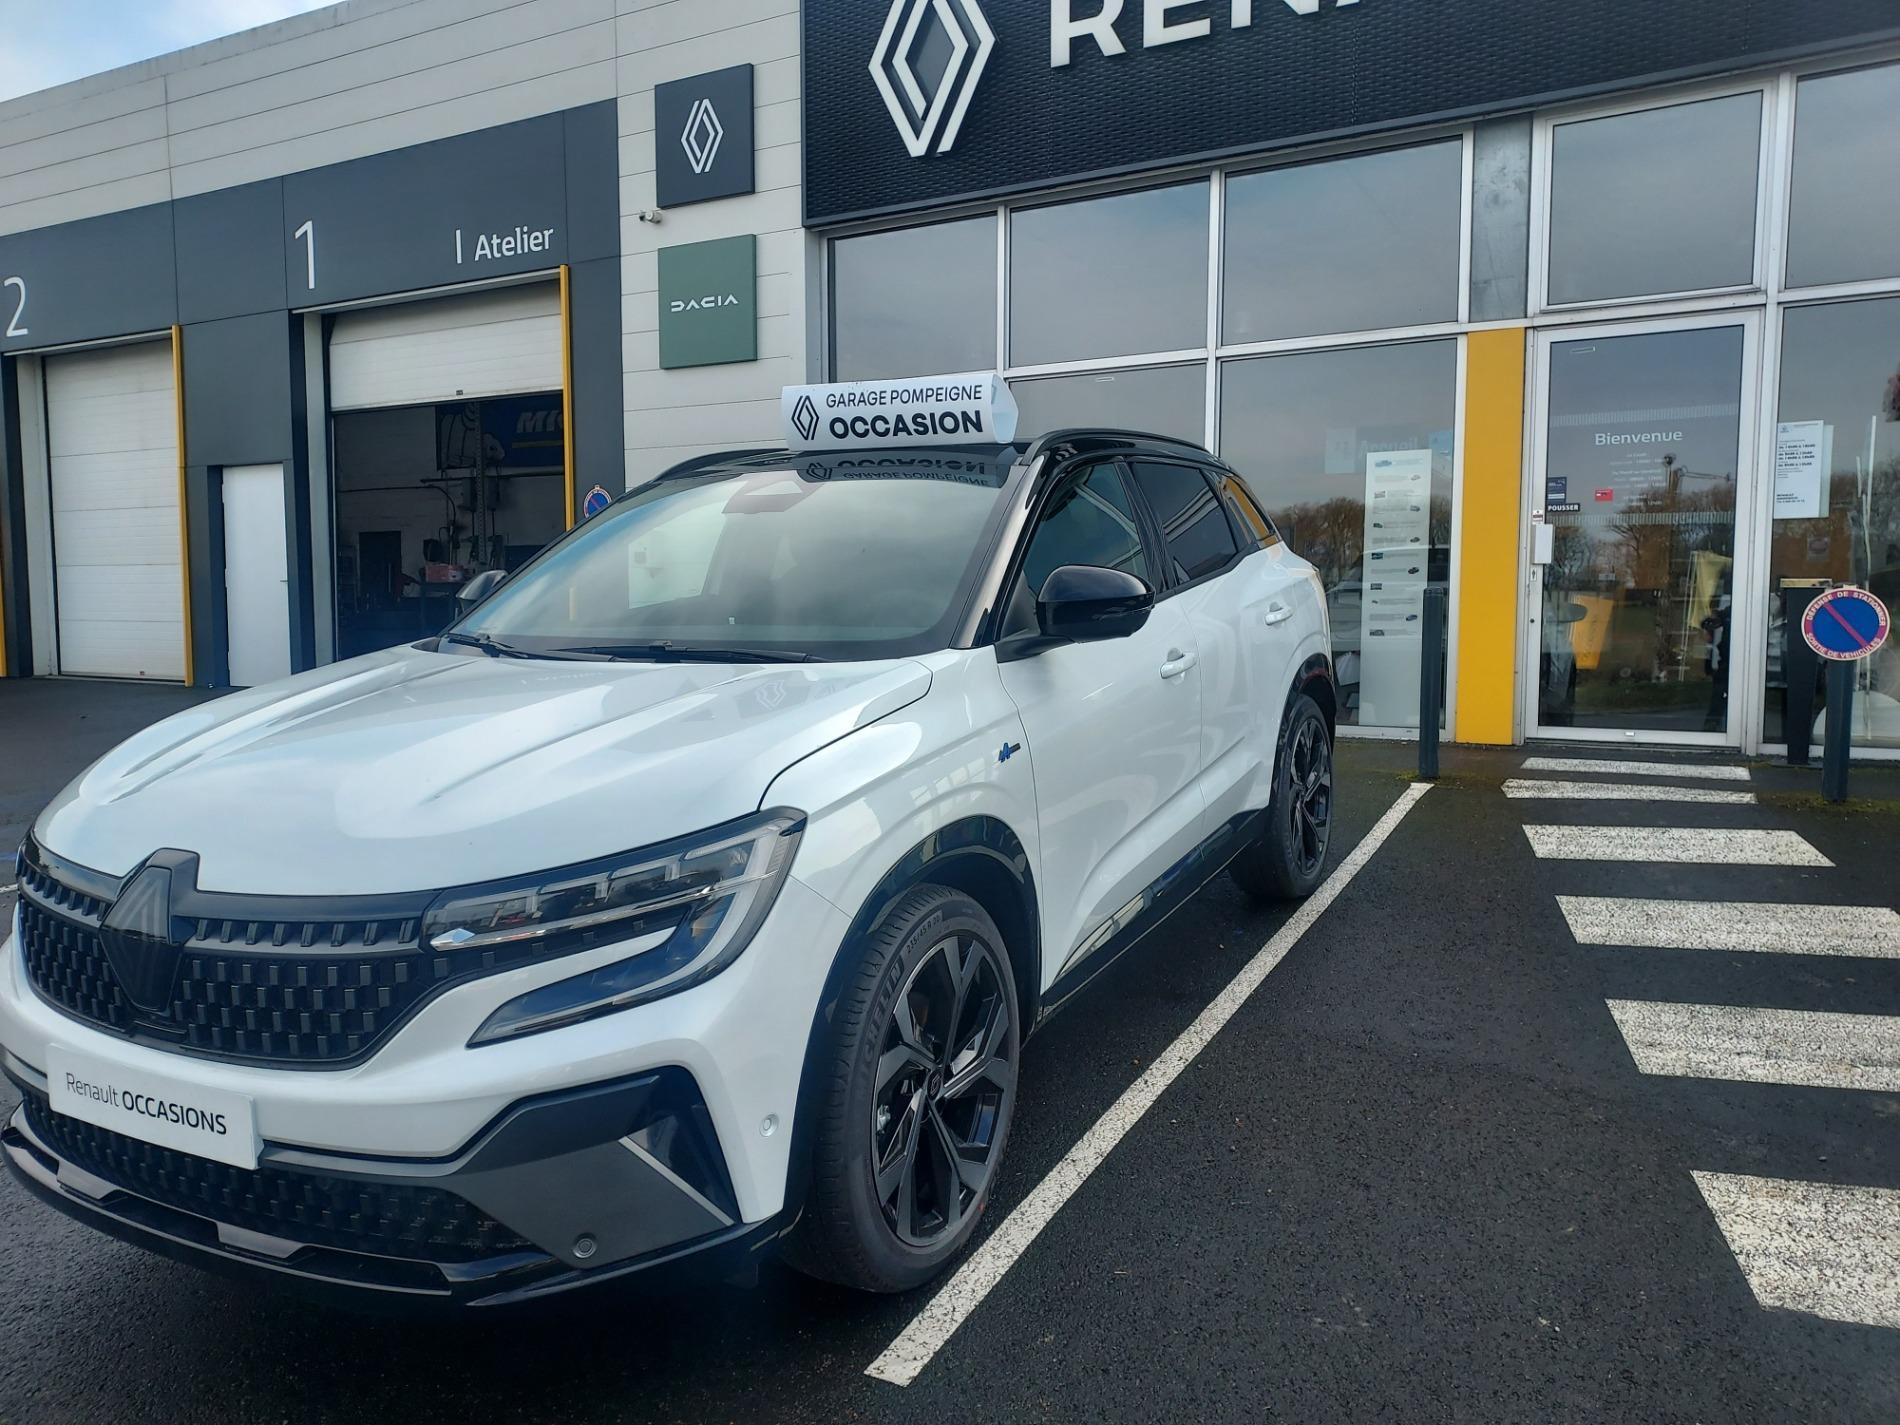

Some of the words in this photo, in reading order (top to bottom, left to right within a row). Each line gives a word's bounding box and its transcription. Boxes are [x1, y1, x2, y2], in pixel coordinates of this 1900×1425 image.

[295, 219, 316, 290] 1
[474, 226, 554, 262] Atelier
[4, 276, 29, 337] 2
[670, 293, 739, 313] DACIA
[826, 390, 887, 408] GARAGE
[890, 384, 983, 405] POMPEIGNE
[829, 409, 984, 439] OCCASION
[1594, 431, 1683, 446] Bienvenue
[1852, 591, 1886, 627] STATIONNER
[1806, 632, 1827, 654] SORTIE
[66, 1072, 120, 1107] Renault
[122, 1091, 227, 1135] OCCASIONS
